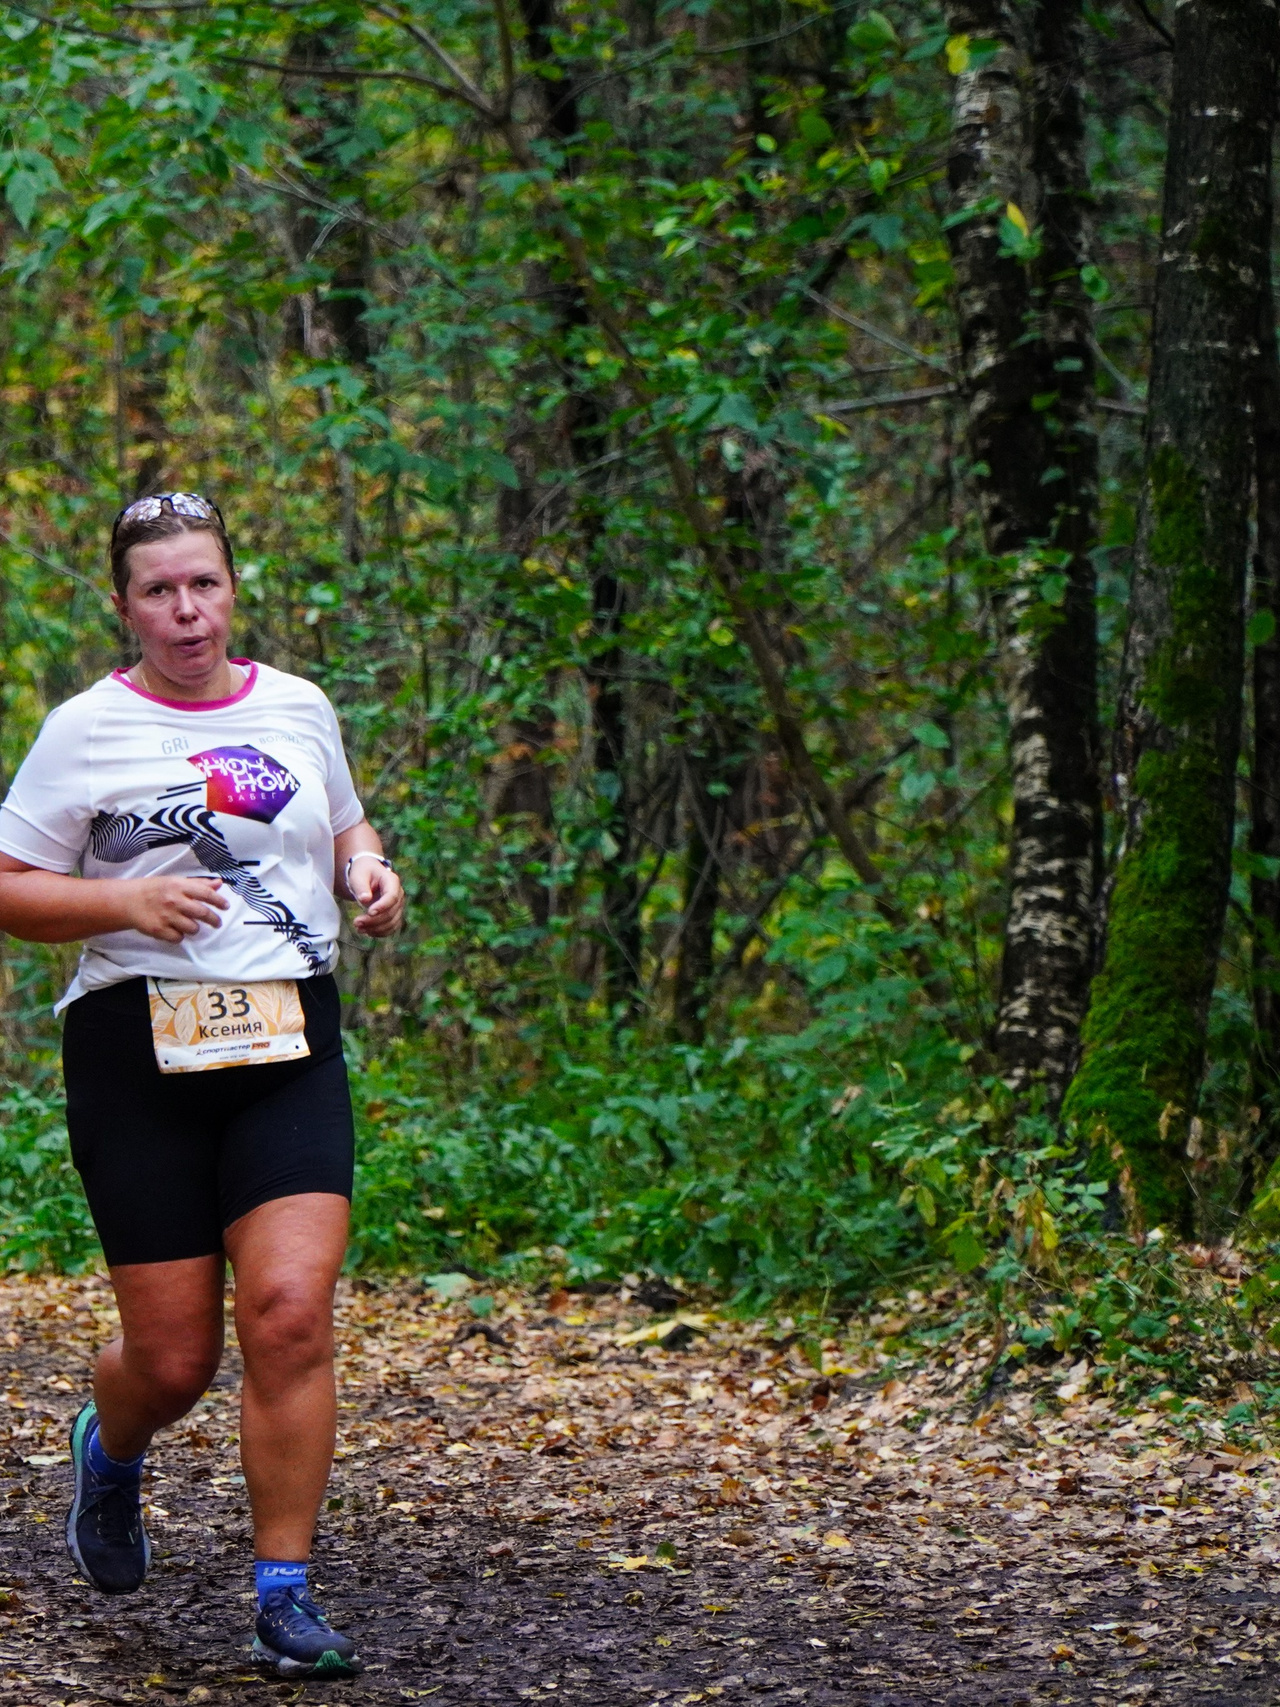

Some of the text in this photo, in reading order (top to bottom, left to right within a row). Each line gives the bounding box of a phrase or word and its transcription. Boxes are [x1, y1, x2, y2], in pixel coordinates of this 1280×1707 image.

[227, 792, 277, 803] ЗАБЕГ
[208, 989, 251, 1021] 33
[199, 1021, 263, 1039] Ксения
[252, 1041, 270, 1050] PRO
